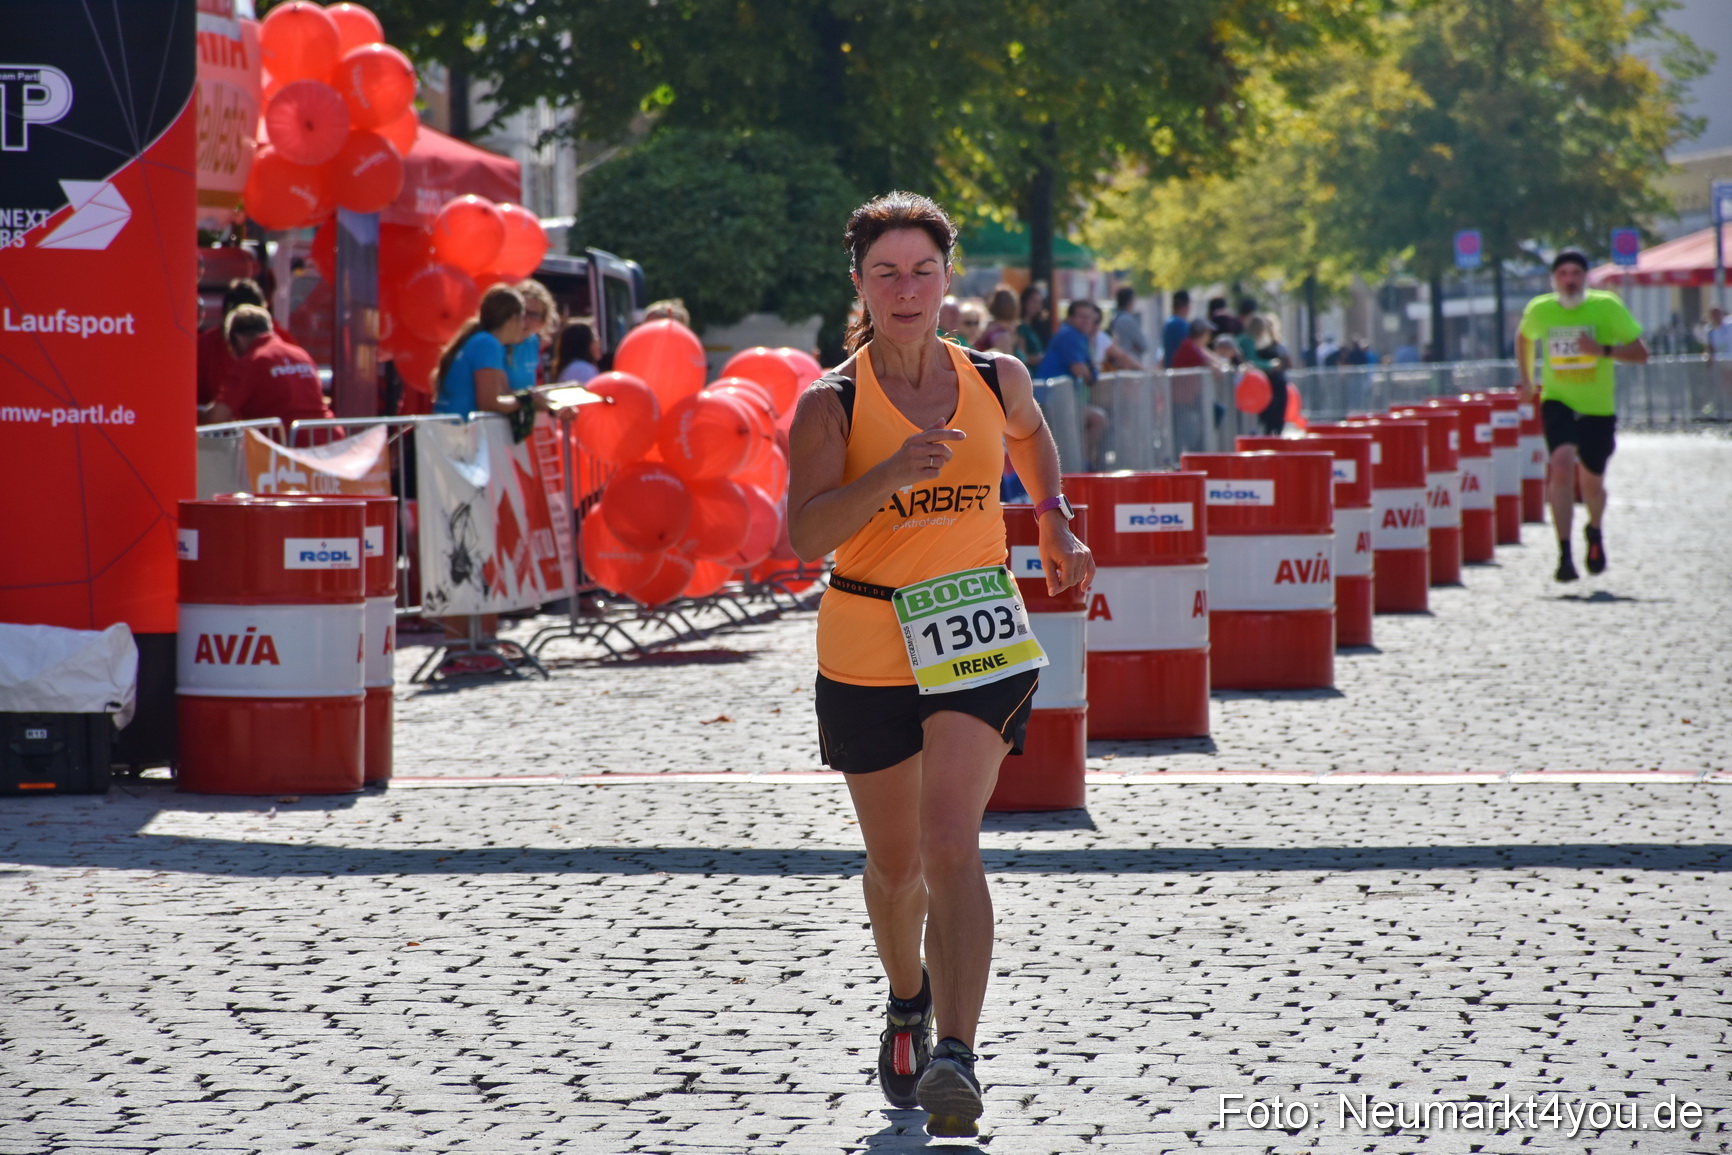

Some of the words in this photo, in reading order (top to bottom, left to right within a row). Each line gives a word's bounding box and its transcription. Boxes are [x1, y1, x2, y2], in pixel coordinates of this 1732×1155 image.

[0, 208, 50, 228] NEXT
[3, 307, 135, 339] Laufsport
[0, 403, 136, 427] mw-partl.de
[904, 571, 1004, 616] BOCK
[921, 605, 1016, 656] 1303
[952, 653, 1008, 677] IRENE
